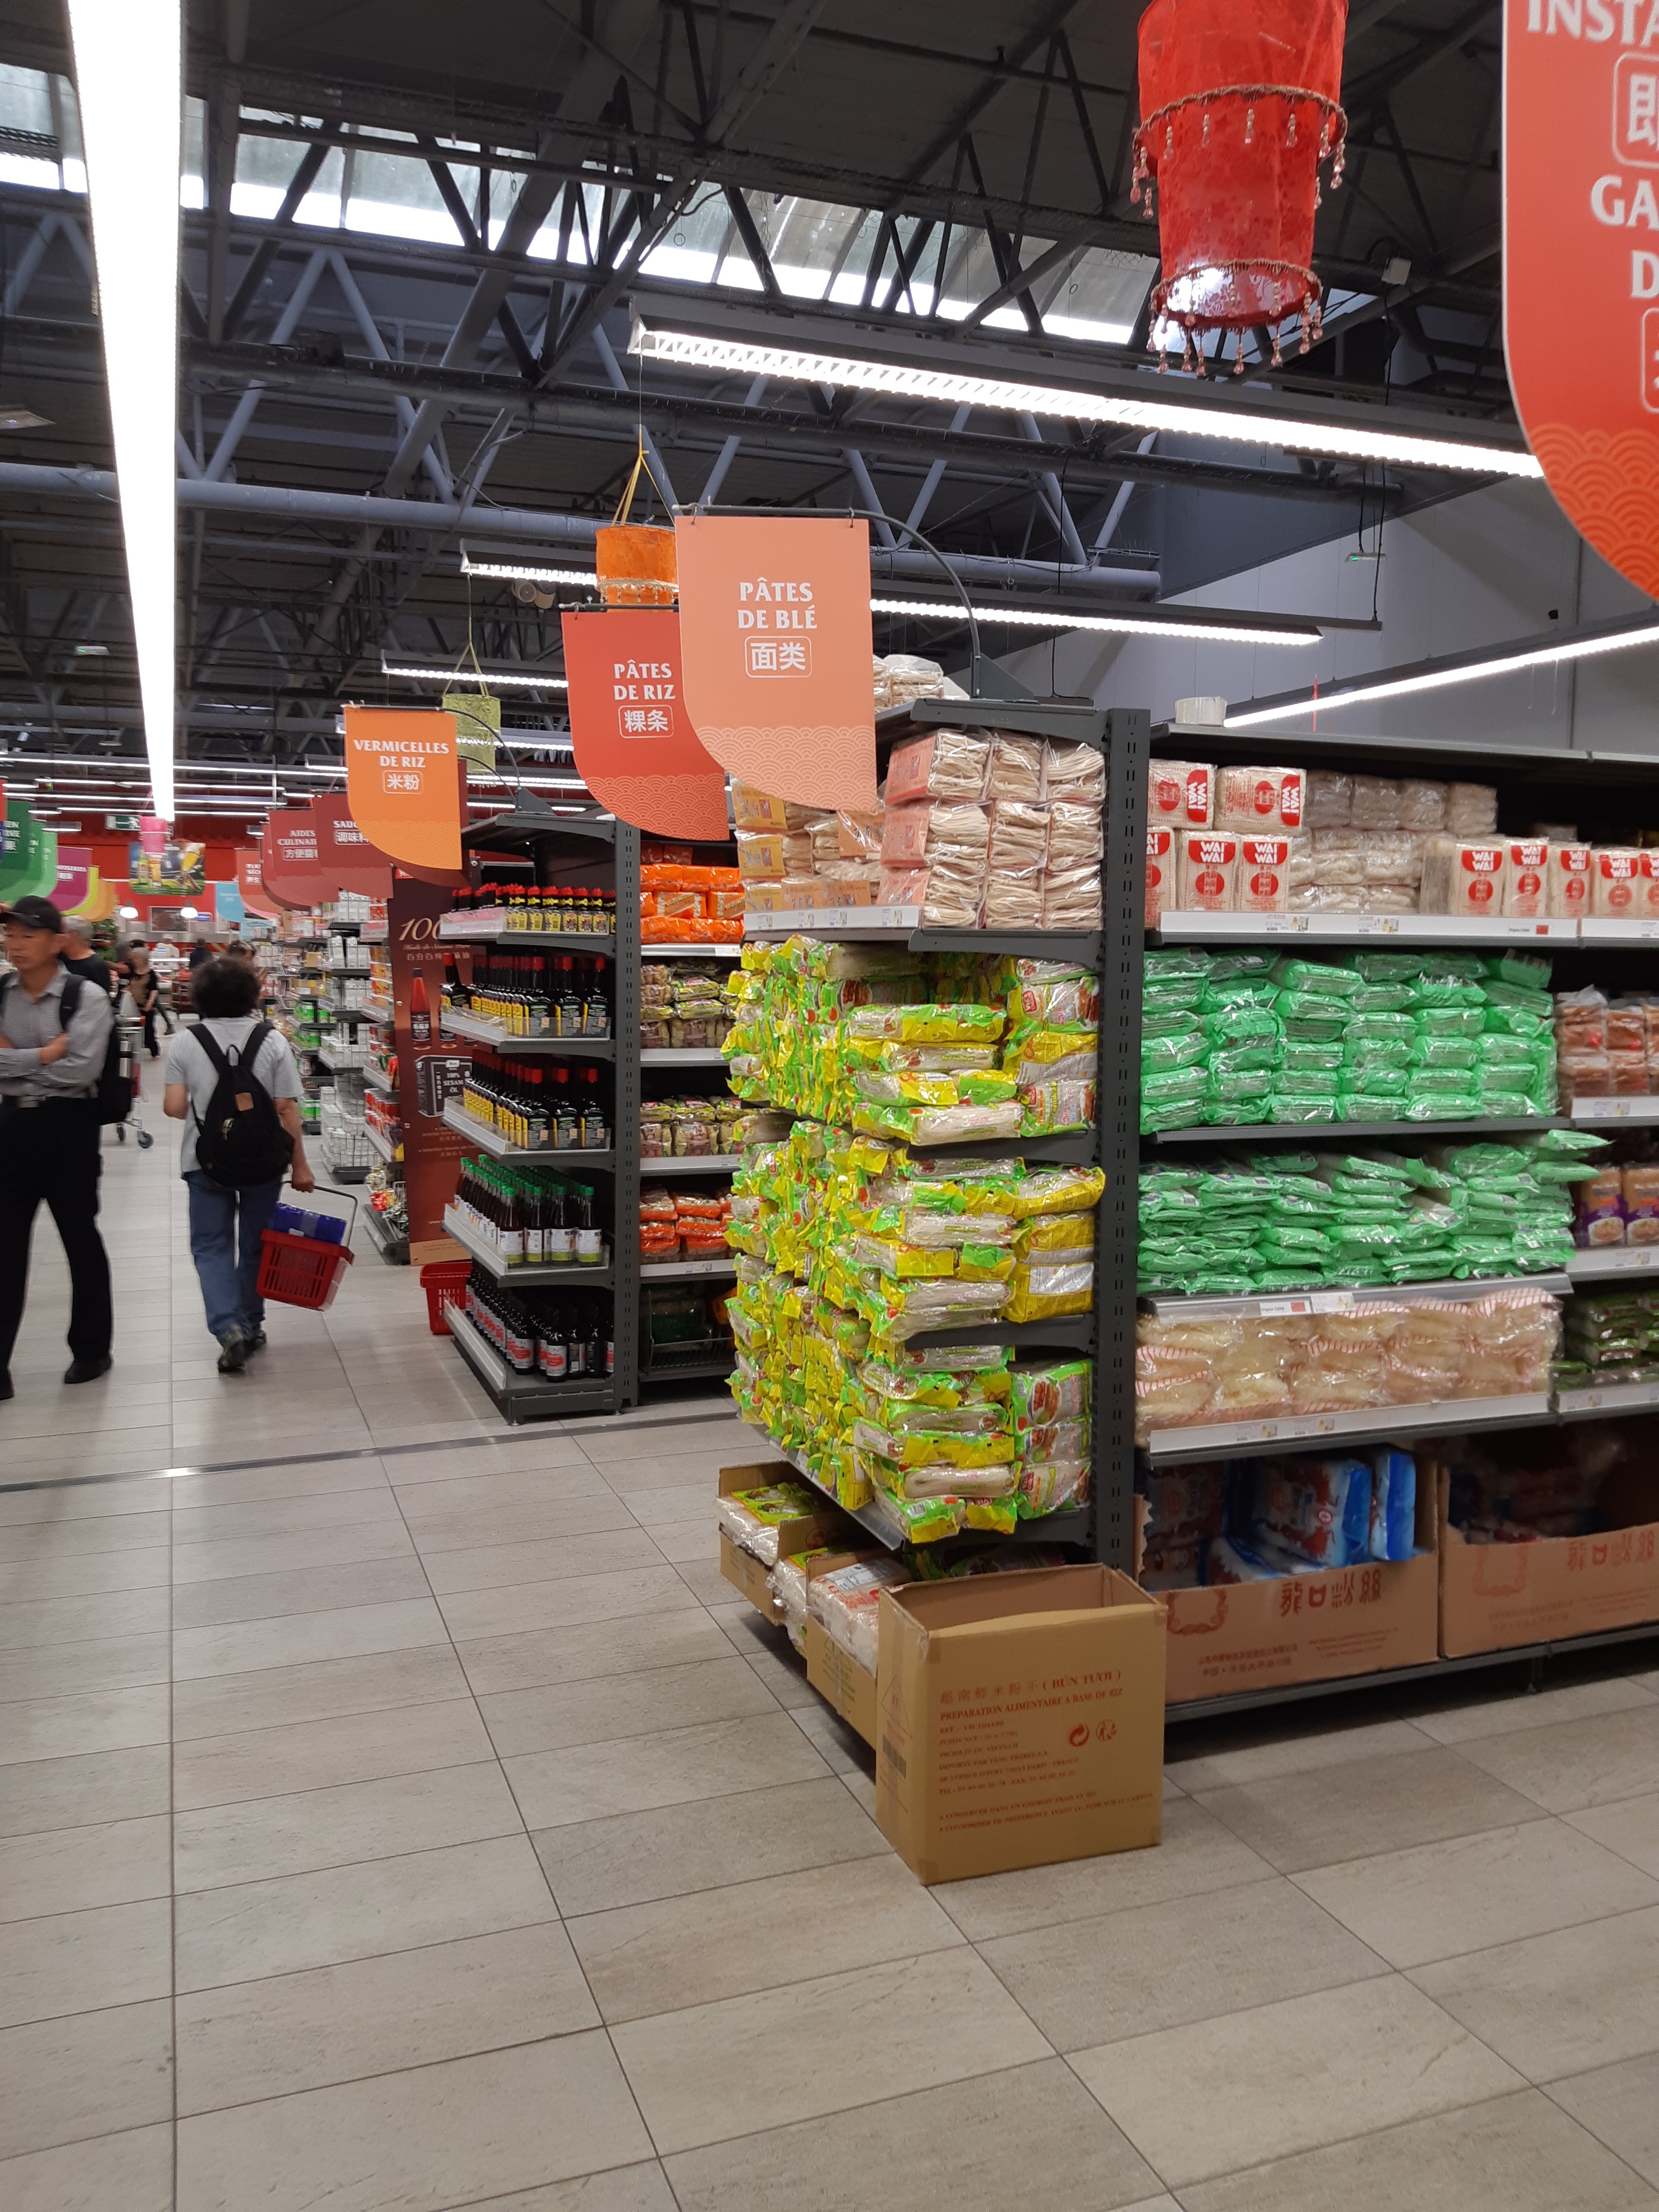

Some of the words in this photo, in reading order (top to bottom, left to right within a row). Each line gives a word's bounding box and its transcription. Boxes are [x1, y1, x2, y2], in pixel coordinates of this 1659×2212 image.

[739, 577, 813, 602] PÂTES
[738, 610, 769, 629] DE
[776, 605, 817, 629] BLÉ
[750, 642, 806, 671] 面类
[613, 659, 672, 679] PÂTES
[613, 685, 639, 700] DE
[643, 685, 675, 700] RIZ
[624, 710, 668, 733] 粿条
[353, 739, 449, 754] VERMICELLES
[379, 756, 398, 767] DE
[402, 757, 426, 768] RIZ
[387, 774, 420, 790] 米粉
[1188, 782, 1198, 809] WAI
[1197, 782, 1206, 810] WAI
[1282, 786, 1291, 813] WAI
[1290, 787, 1299, 814] WAI
[1201, 842, 1225, 853] WAI
[1254, 843, 1277, 853] WAI
[1521, 846, 1541, 856] WAI
[1201, 852, 1224, 863] WAI
[1255, 853, 1277, 864] WAI
[1472, 852, 1494, 862] WAI
[1521, 855, 1540, 865] WAI
[1570, 851, 1586, 861] WAI
[1472, 861, 1494, 871] WAI
[1569, 860, 1586, 870] WAI
[1612, 858, 1631, 868] WAI
[1611, 868, 1631, 878] WAI
[940, 1706, 1002, 1720] PREPARATION
